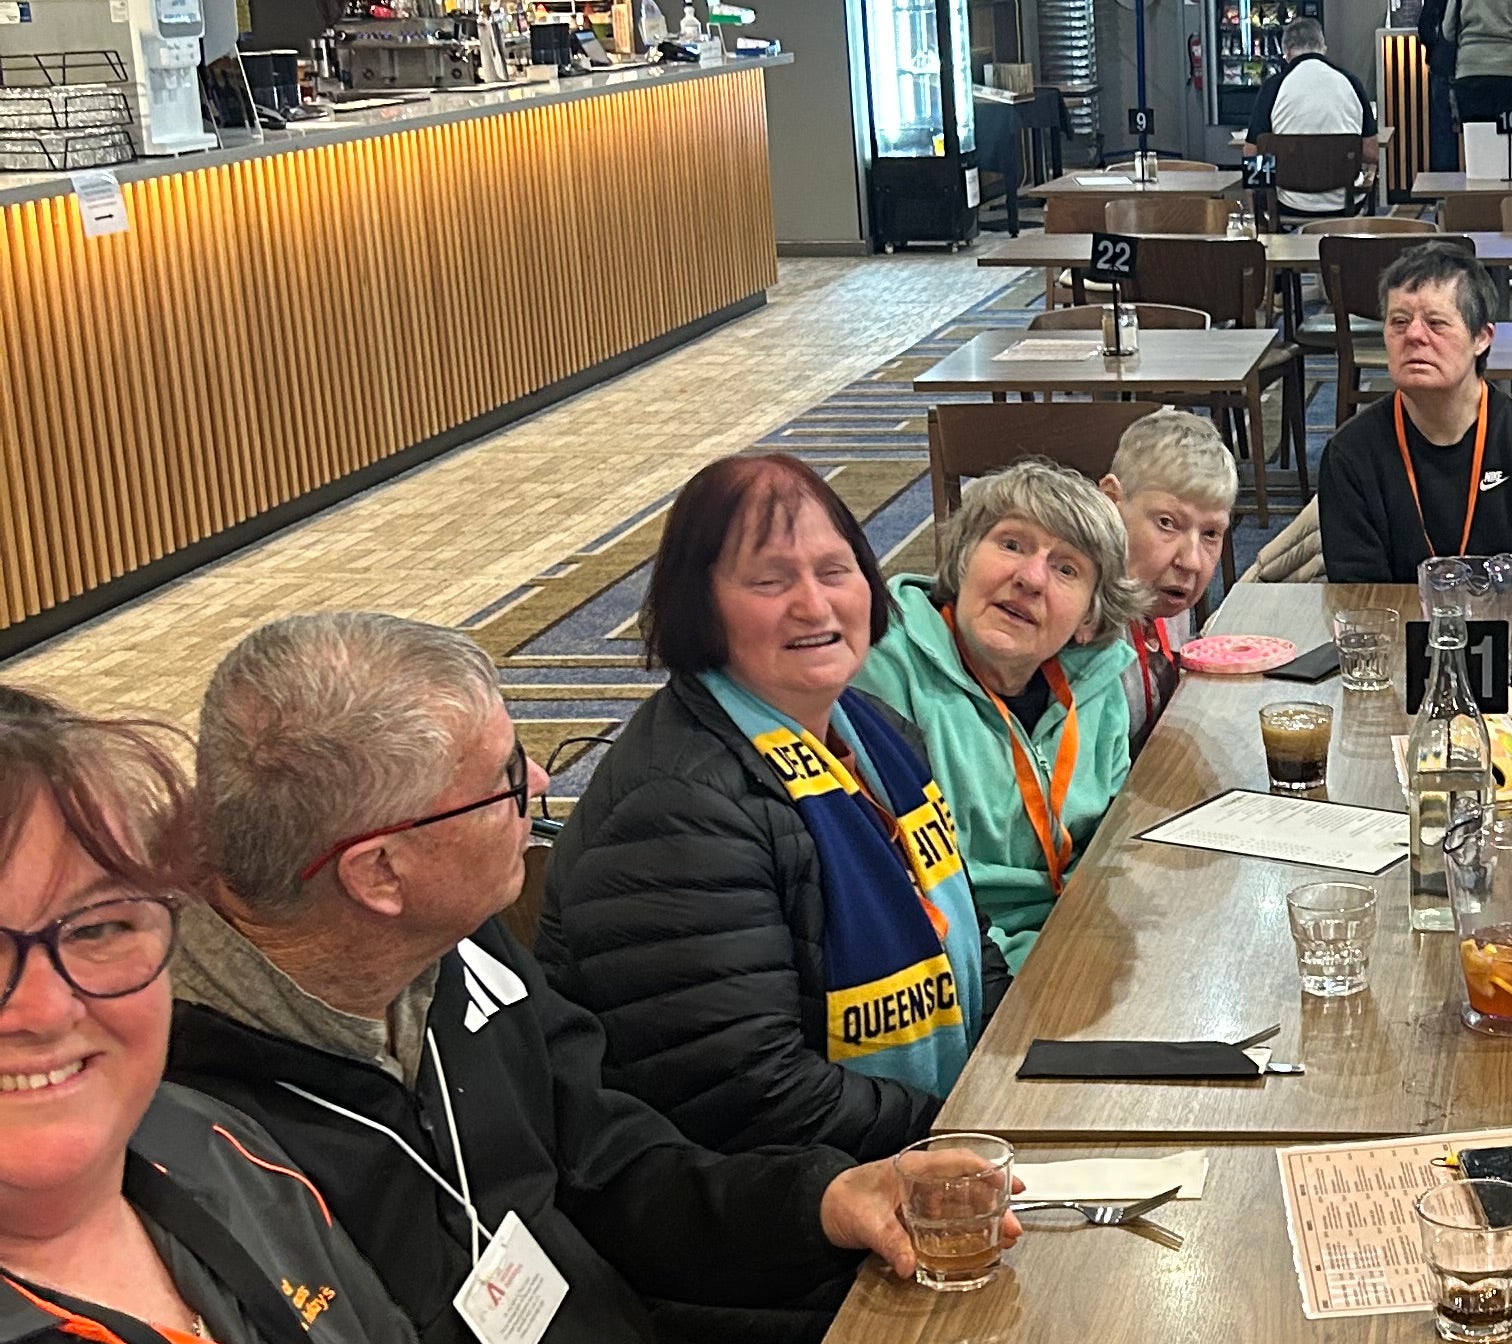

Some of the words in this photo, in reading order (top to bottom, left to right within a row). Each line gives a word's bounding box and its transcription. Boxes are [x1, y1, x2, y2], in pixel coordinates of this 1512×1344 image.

[1136, 112, 1147, 132] 9
[1246, 159, 1271, 185] 21
[1096, 239, 1131, 272] 22
[843, 971, 954, 1046] QUEENSC
